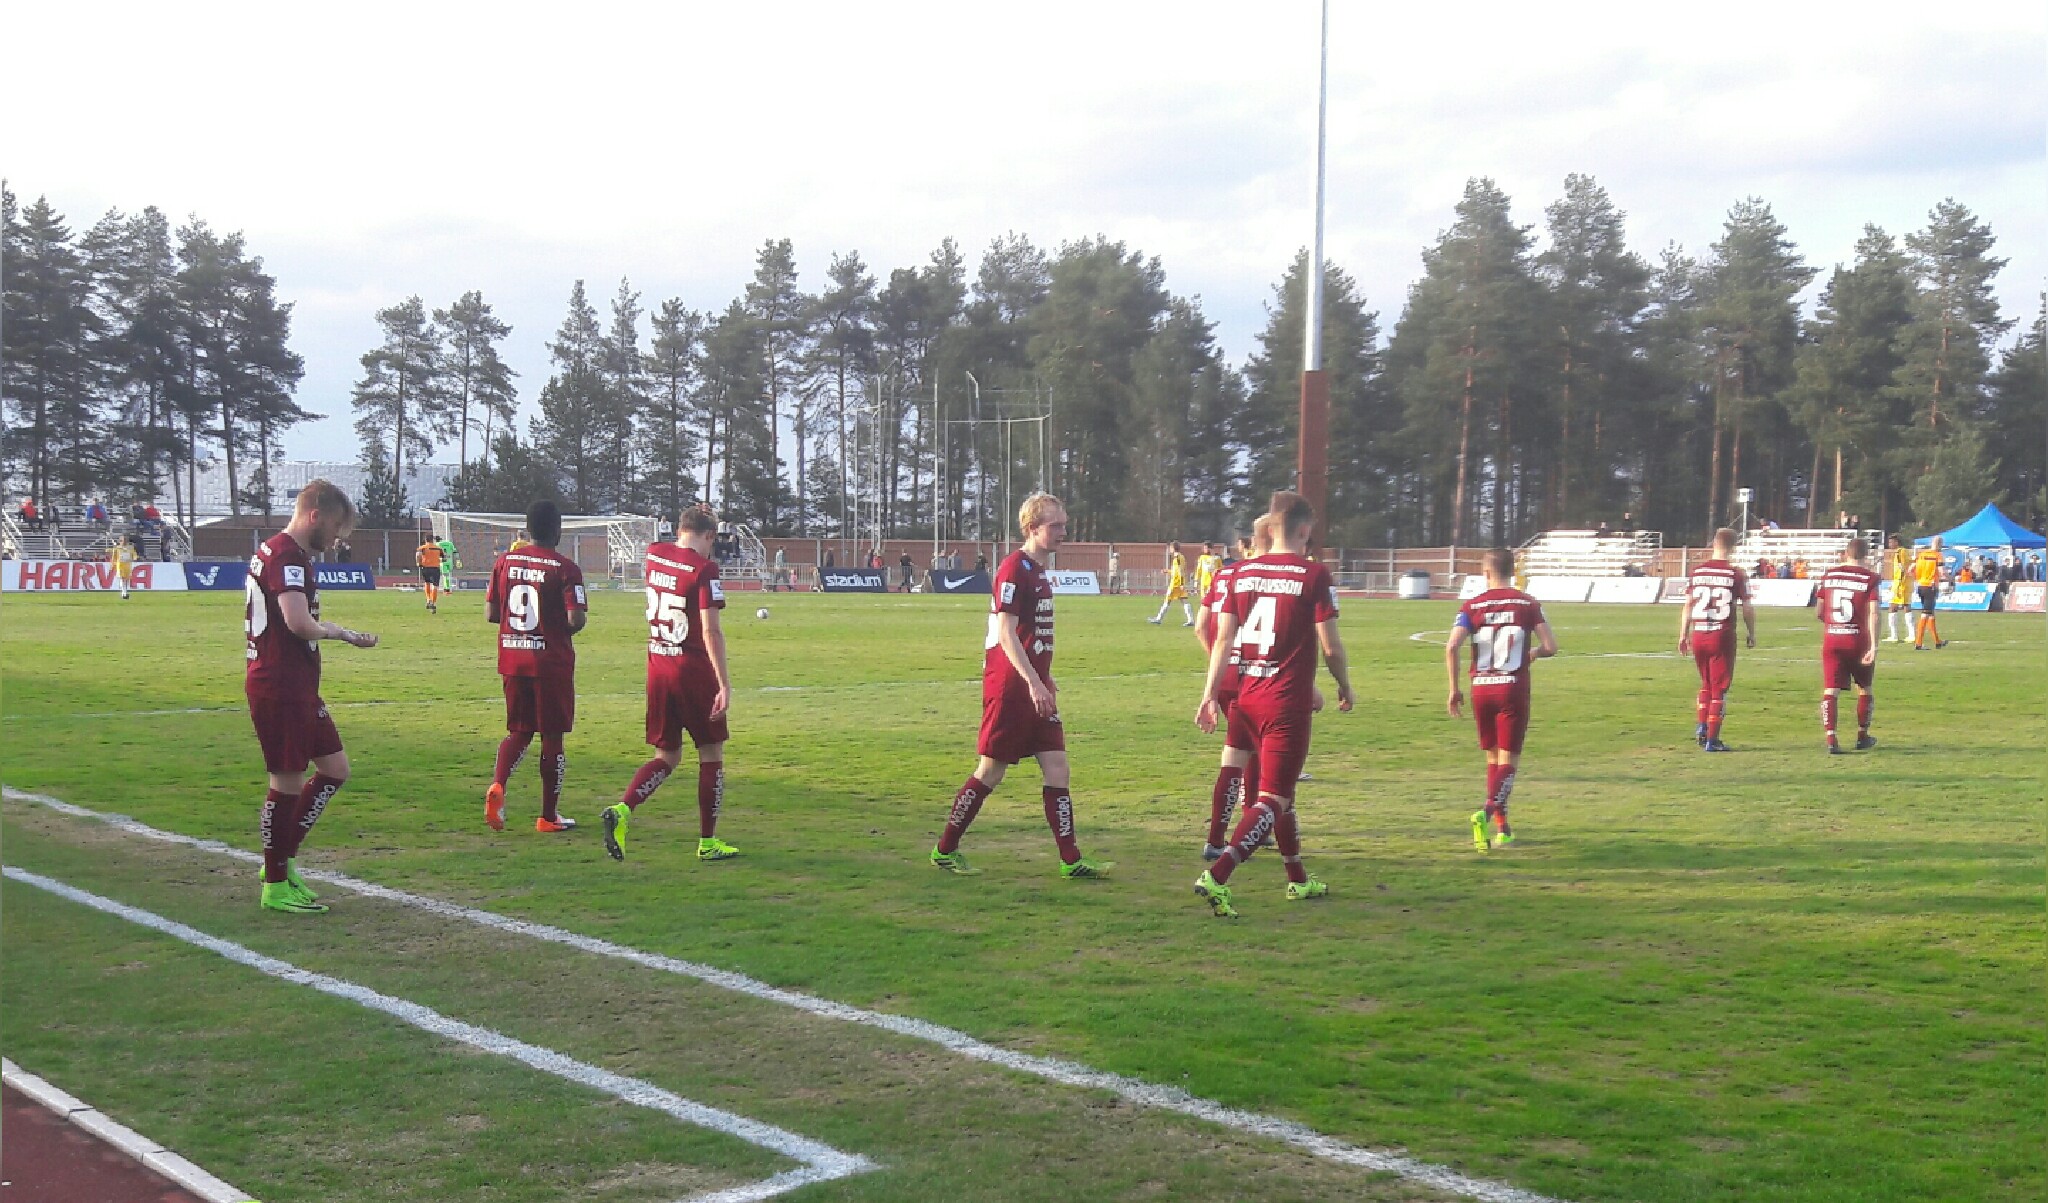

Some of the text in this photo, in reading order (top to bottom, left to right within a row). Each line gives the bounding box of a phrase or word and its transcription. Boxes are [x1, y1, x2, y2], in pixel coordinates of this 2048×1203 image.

[19, 562, 154, 589] HARVA
[318, 571, 366, 584] AUS.FI
[508, 567, 546, 583] ETOCK
[649, 570, 677, 591] AHDE
[825, 573, 882, 587] stadium
[1059, 576, 1091, 586] LEHTO
[509, 584, 540, 631] 9
[645, 586, 690, 645] 25
[1691, 586, 1733, 621] 23
[1831, 589, 1854, 623] 5
[1240, 596, 1277, 655] 4
[1473, 625, 1525, 671] 10
